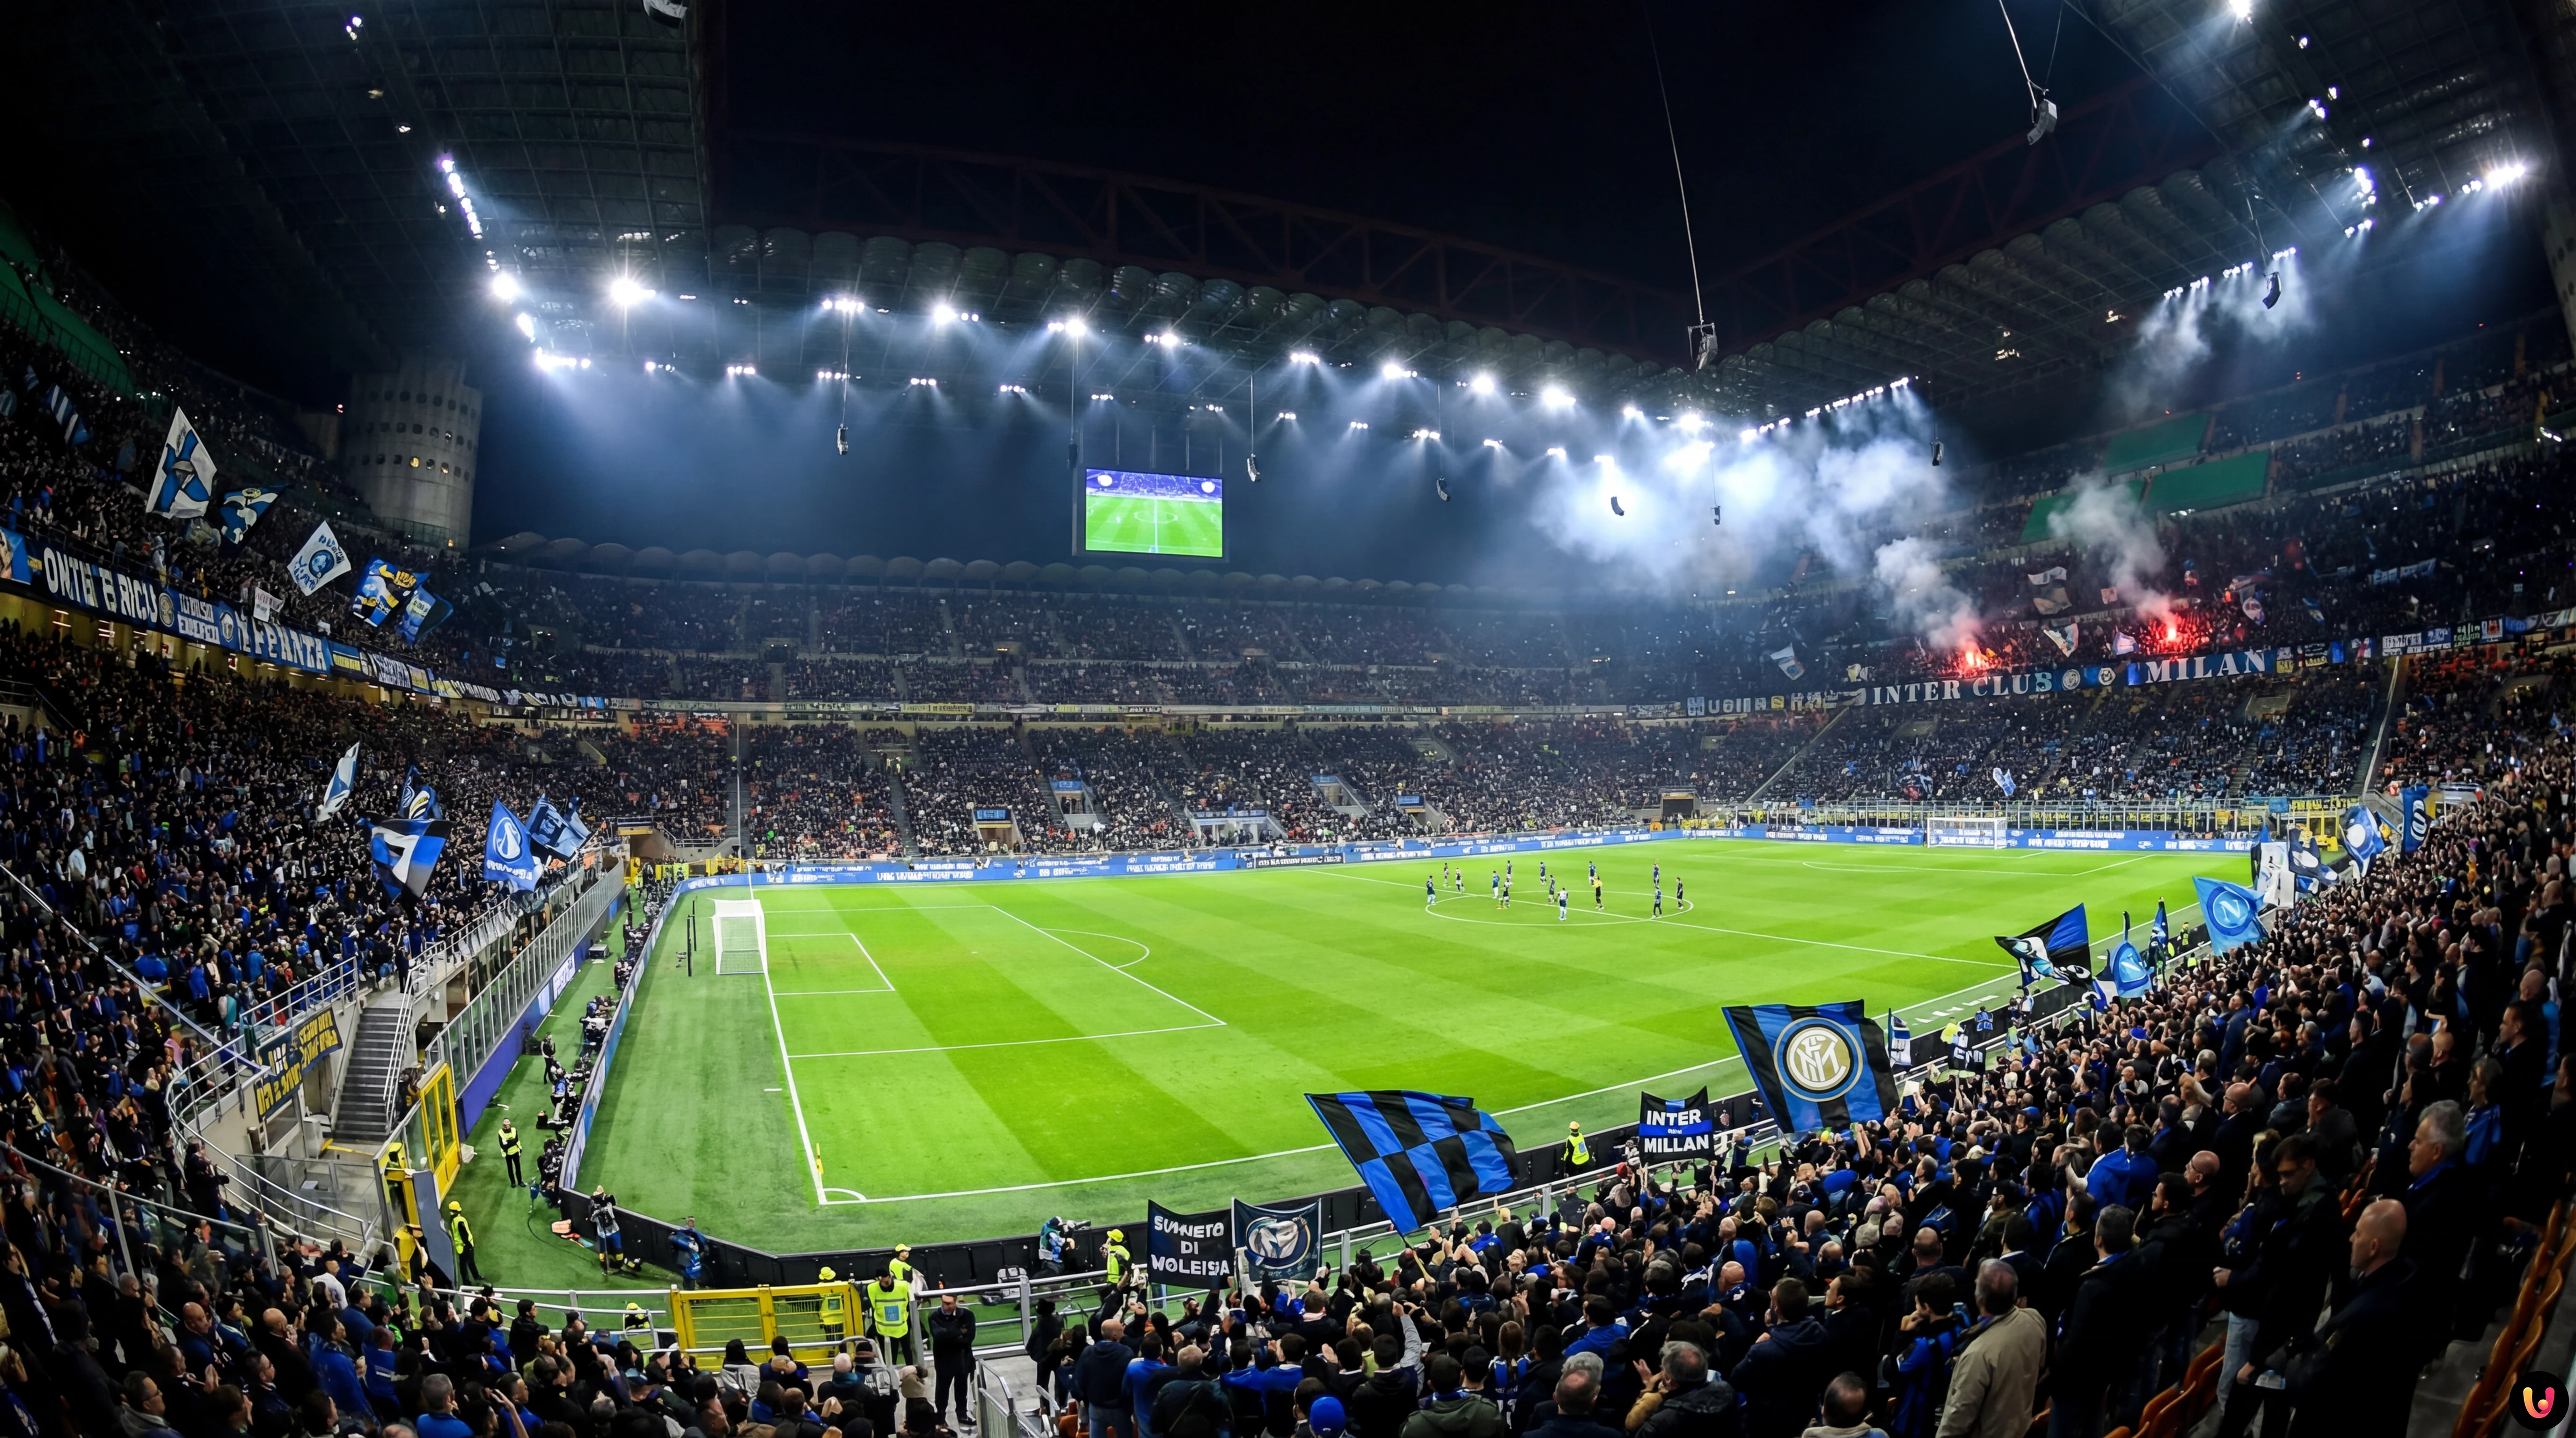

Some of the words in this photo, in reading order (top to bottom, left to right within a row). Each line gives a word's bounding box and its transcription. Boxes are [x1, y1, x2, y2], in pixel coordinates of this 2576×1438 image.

[1873, 680, 1961, 705] INTER
[2145, 649, 2266, 683] MILAN
[1647, 1109, 1701, 1126] INTER
[1644, 1134, 1709, 1153] MILLAN
[1181, 1240, 1198, 1255] DI
